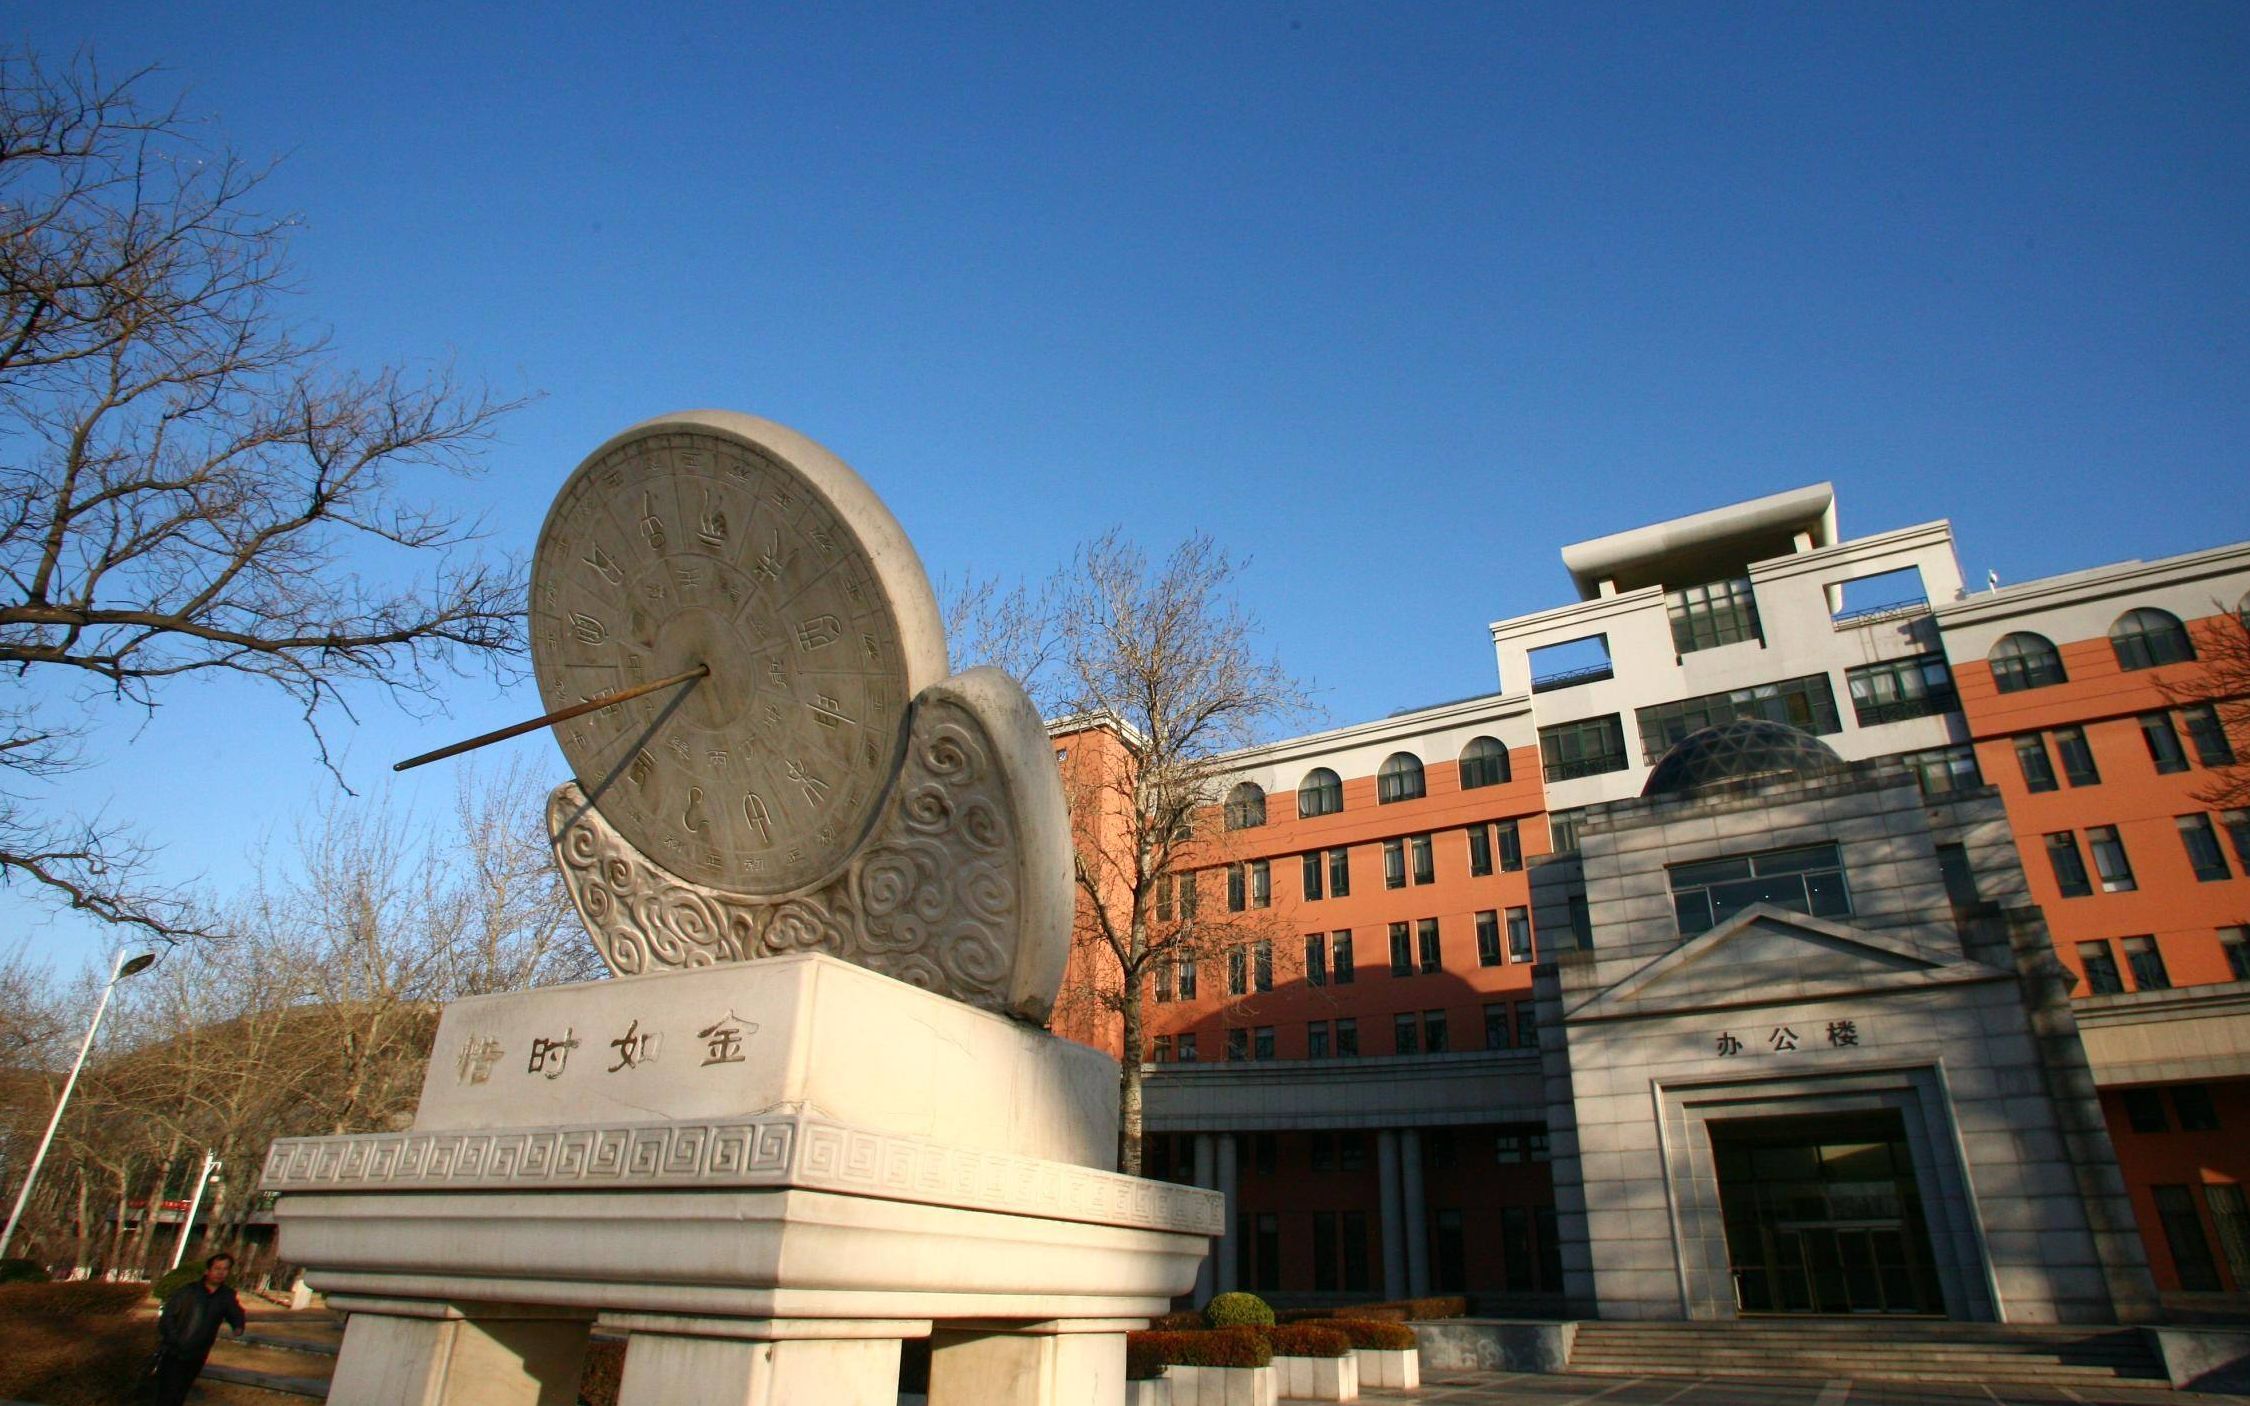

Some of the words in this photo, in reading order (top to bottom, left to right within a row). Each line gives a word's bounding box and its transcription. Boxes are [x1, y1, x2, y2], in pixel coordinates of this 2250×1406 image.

[455, 1008, 760, 1087] 惜时如金
[1716, 1020, 1858, 1056] 办公楼
